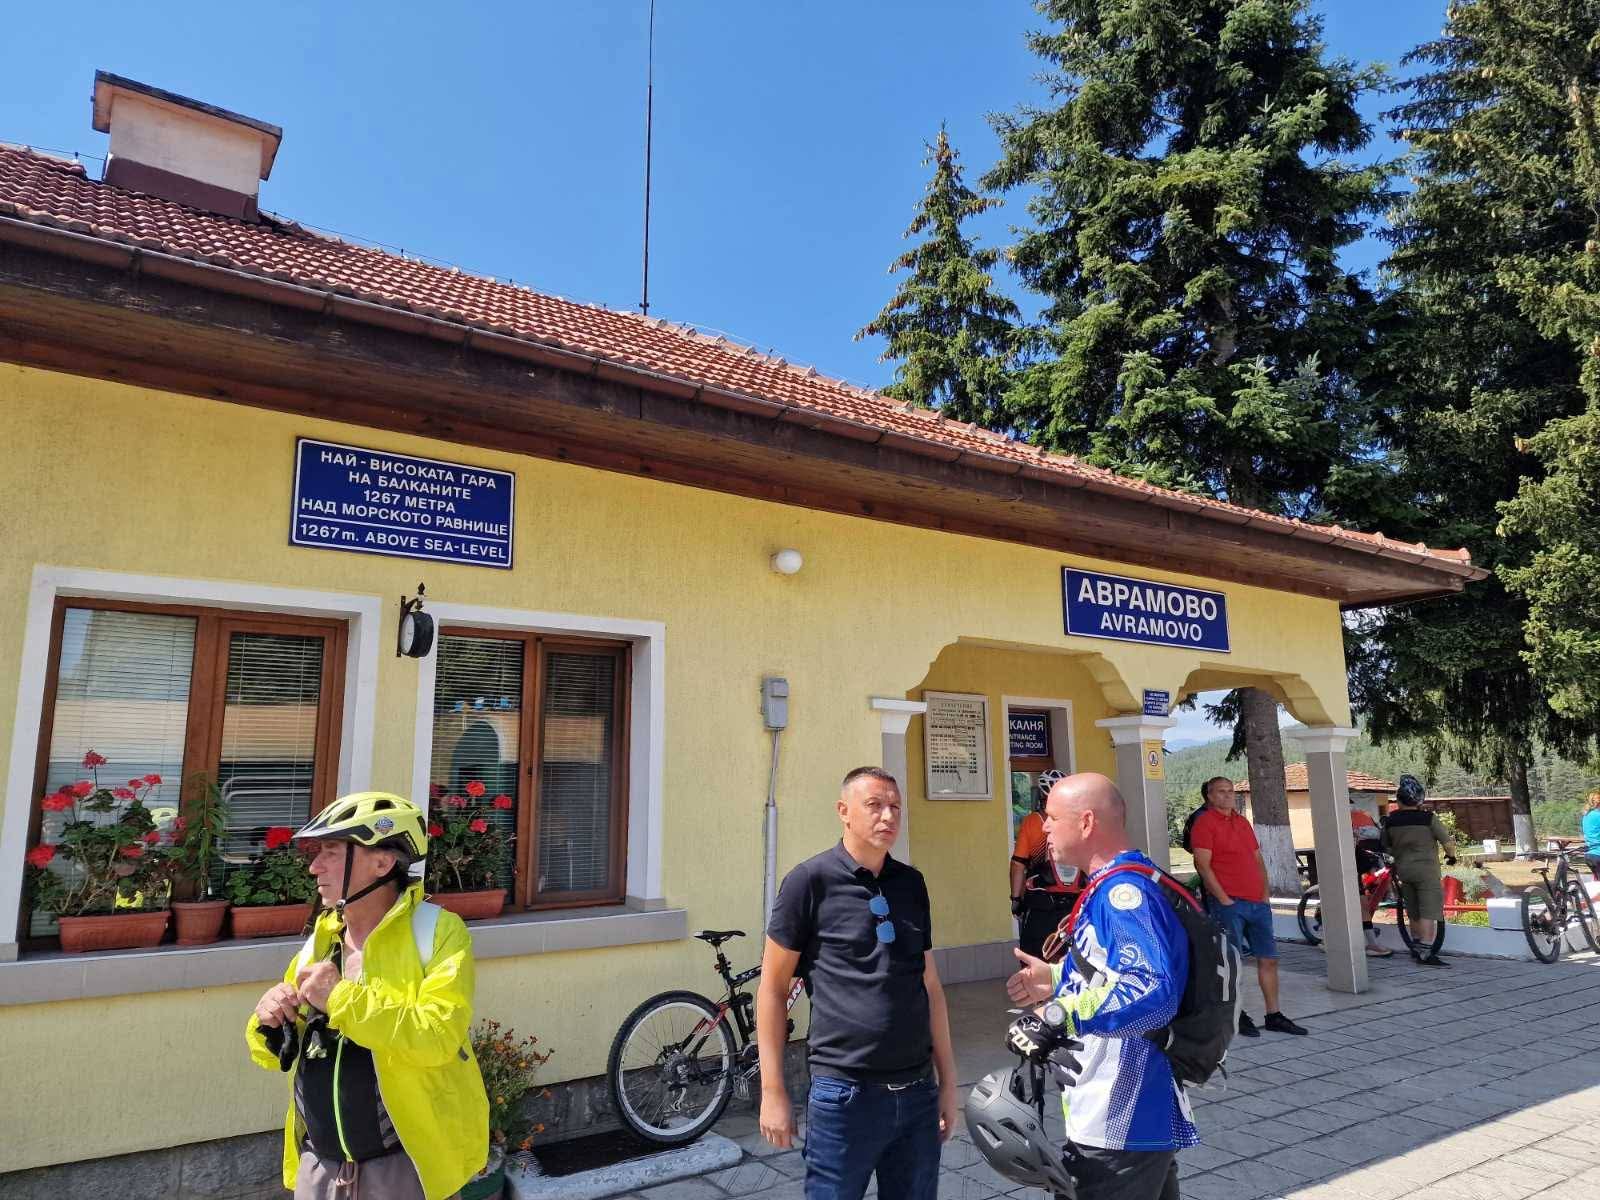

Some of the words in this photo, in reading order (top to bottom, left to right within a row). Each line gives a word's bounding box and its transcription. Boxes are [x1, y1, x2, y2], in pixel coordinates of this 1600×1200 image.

[349, 471, 371, 485] НА
[378, 475, 472, 500] БАЛКАНИТЕ
[461, 473, 497, 489] ГАРА
[363, 489, 400, 504] 1267
[404, 495, 456, 514] МЕТРА
[301, 498, 337, 515] НАД
[342, 503, 432, 526] МОРСКОТО
[436, 516, 508, 537] РАВНИЩЕ
[365, 531, 420, 549] ABOVE
[424, 538, 507, 559] SEA-LEVEL
[1078, 577, 1218, 621] АВРАМОВО
[1100, 611, 1203, 642] AVRAMOVO
[1009, 719, 1044, 731] КАЛНЯ
[1008, 1025, 1040, 1056] FOX
